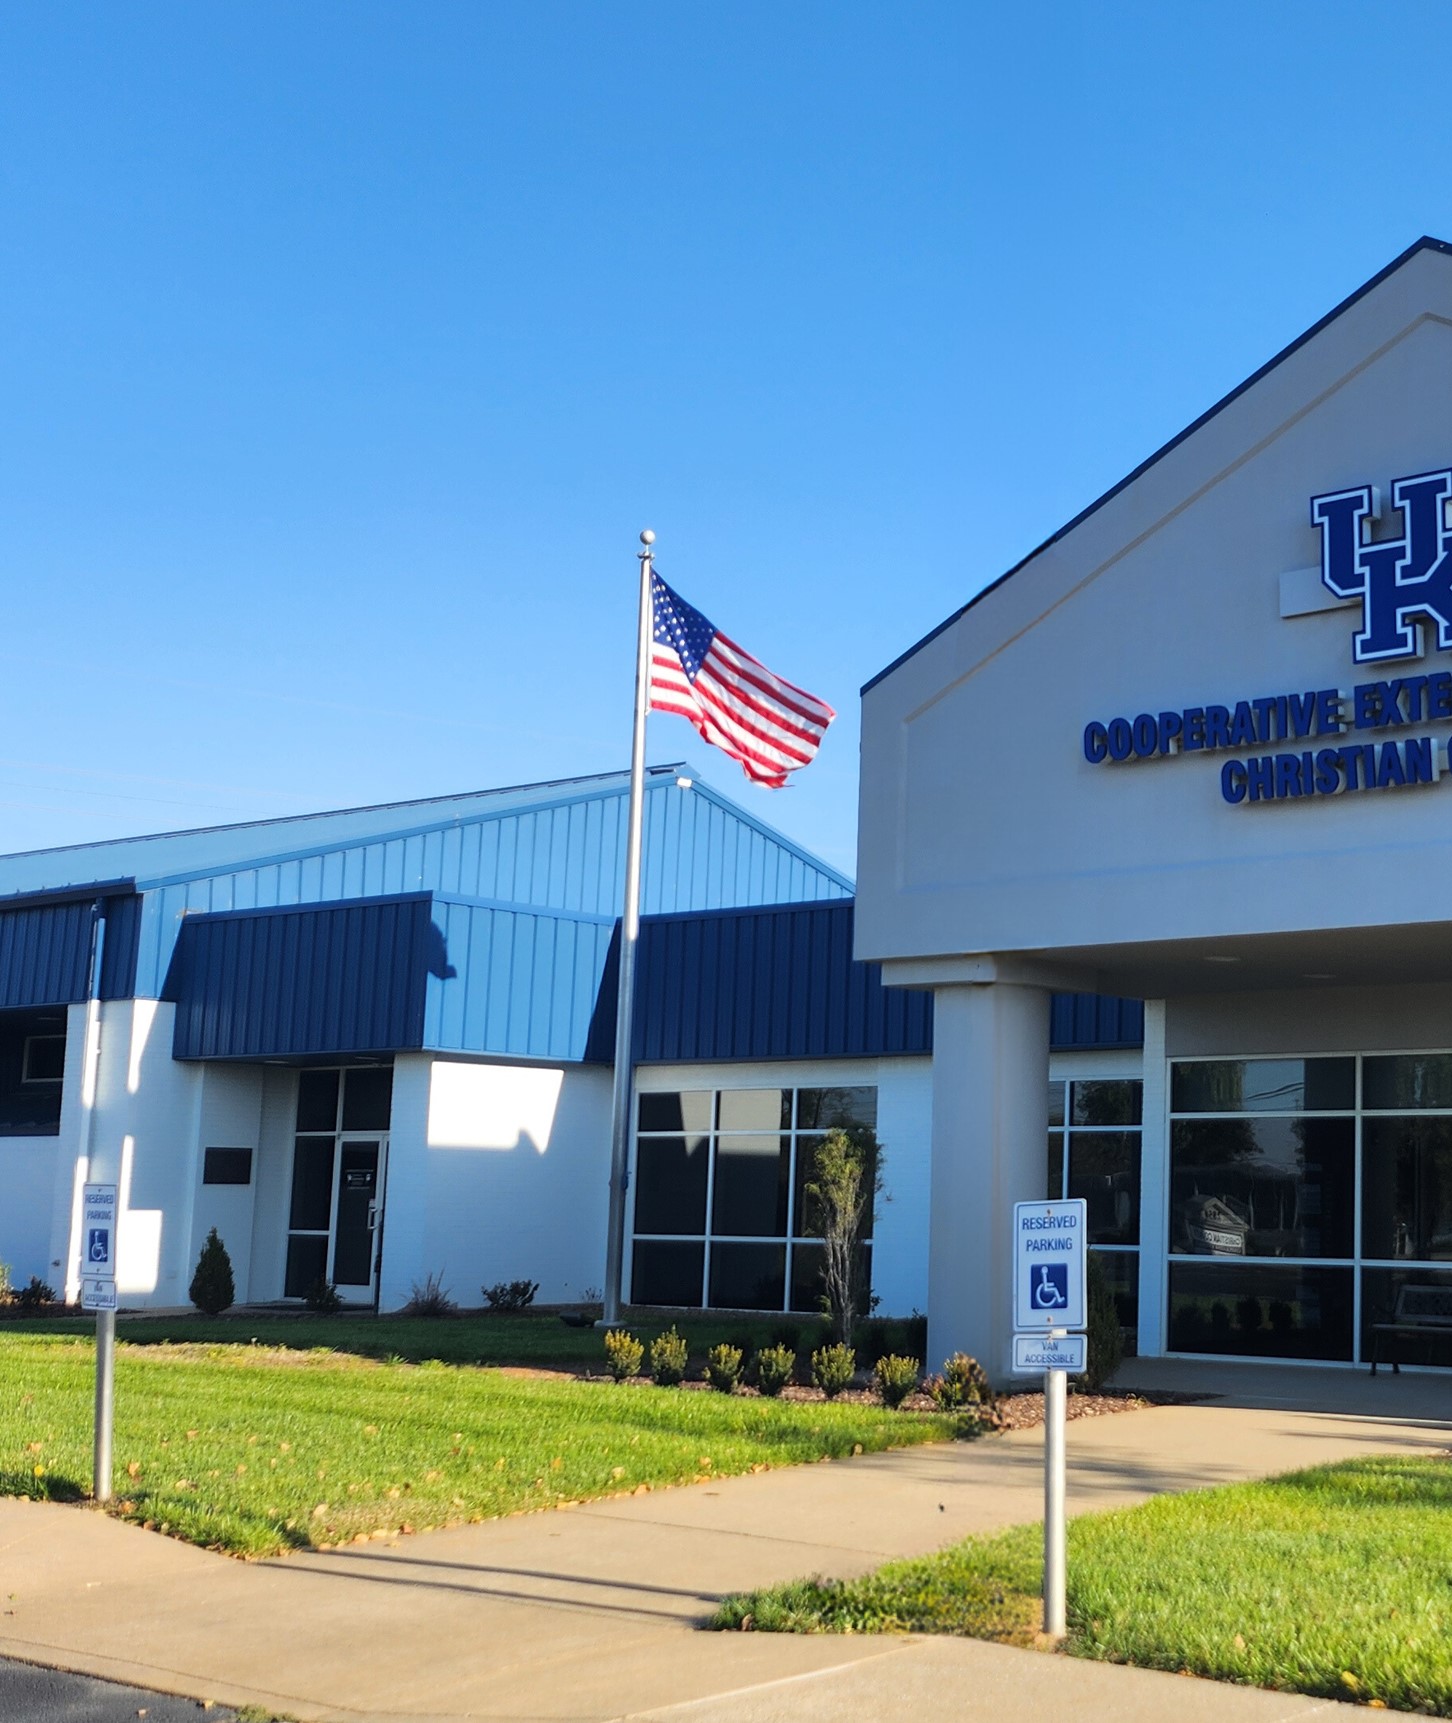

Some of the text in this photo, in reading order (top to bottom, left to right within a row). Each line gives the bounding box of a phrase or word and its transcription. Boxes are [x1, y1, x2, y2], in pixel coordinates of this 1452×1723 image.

[1083, 689, 1342, 764] COOPERATIVE
[1221, 737, 1436, 804] CHRISTIAN
[85, 1194, 114, 1204] RESERVED
[86, 1209, 112, 1220] PARKING
[1022, 1215, 1077, 1230] RESERVED
[1026, 1237, 1073, 1251] PARKING
[1042, 1341, 1058, 1351] VAN
[1024, 1353, 1075, 1364] ACCESSIBLE
